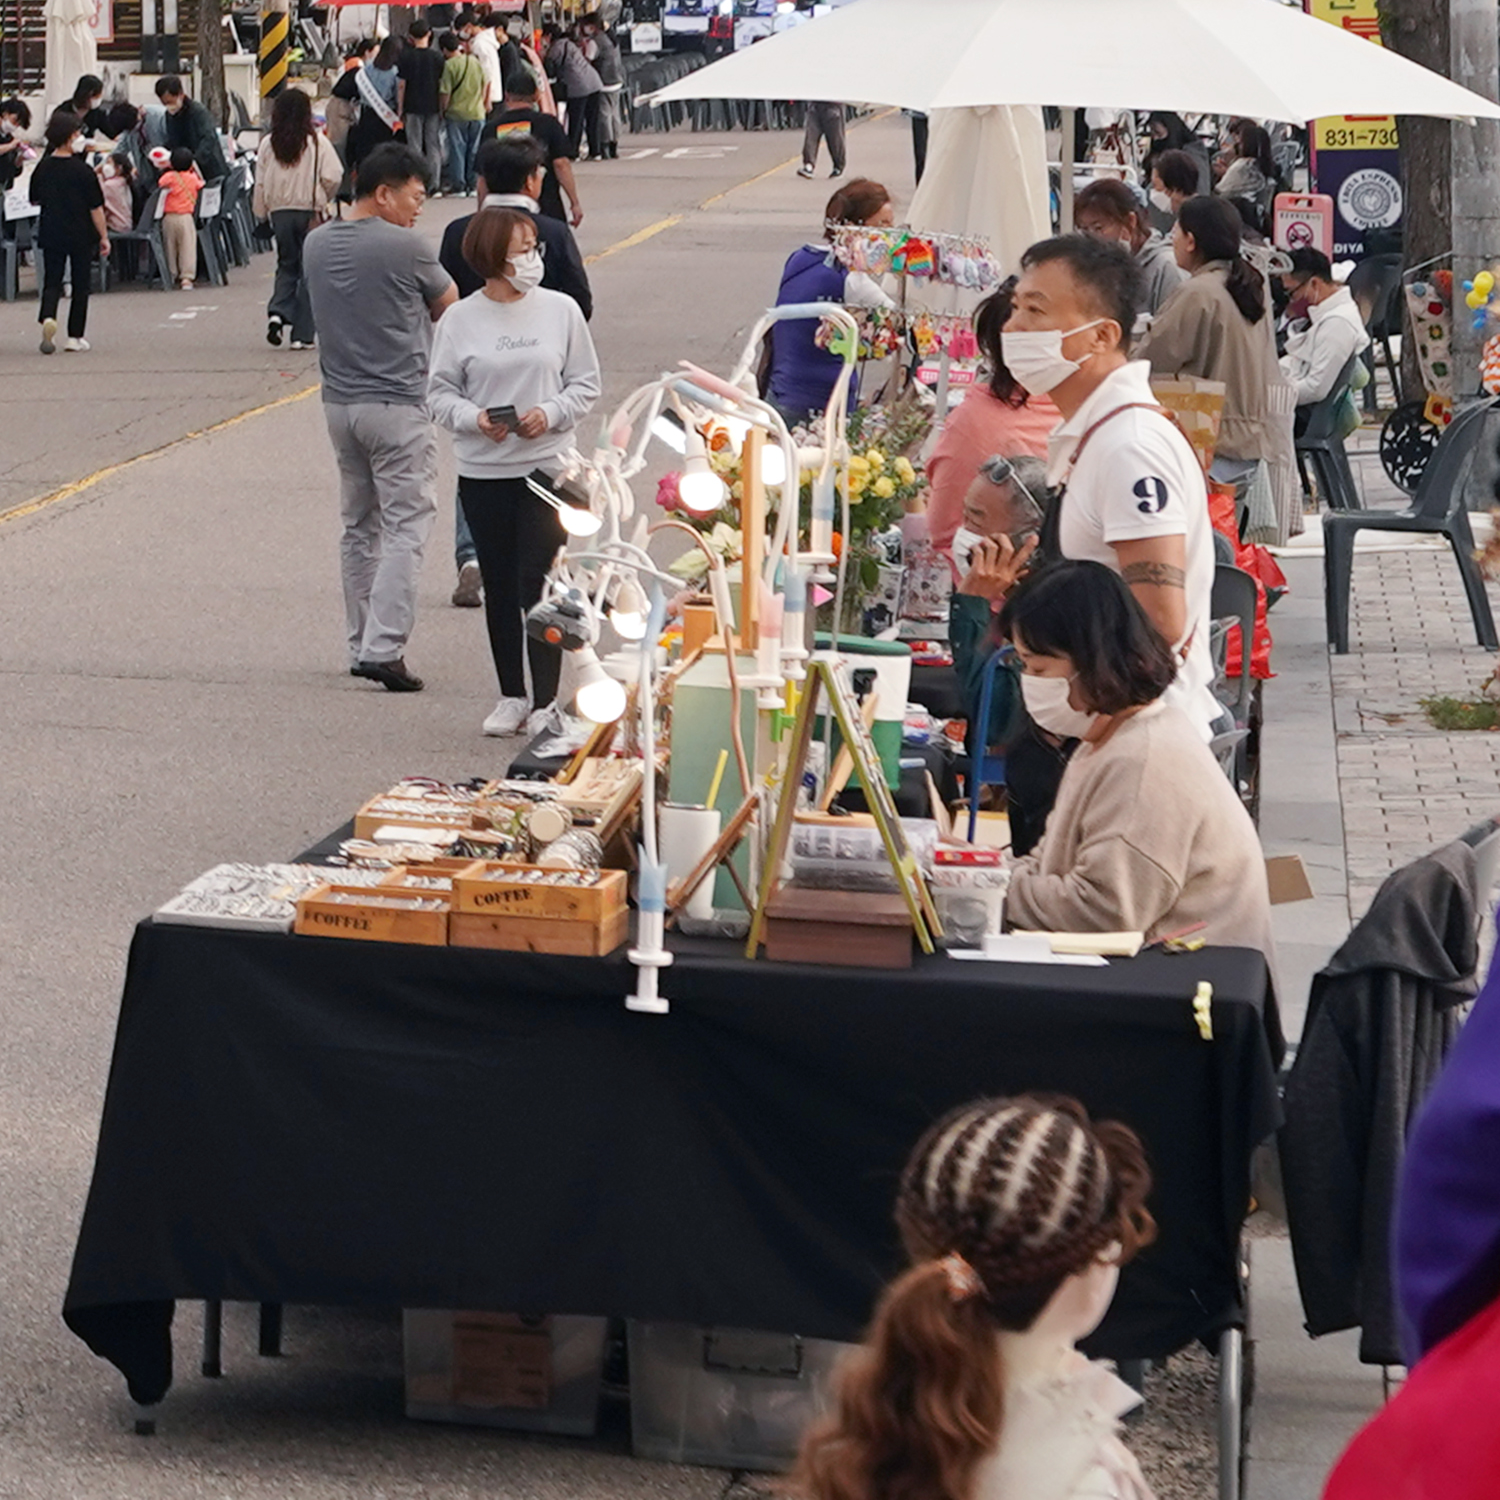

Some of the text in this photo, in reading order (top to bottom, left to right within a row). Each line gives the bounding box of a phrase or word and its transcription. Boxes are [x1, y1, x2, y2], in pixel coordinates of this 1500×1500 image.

[1133, 476, 1168, 514] 9
[474, 888, 533, 907] COFFEE
[313, 911, 372, 931] COFFEE
